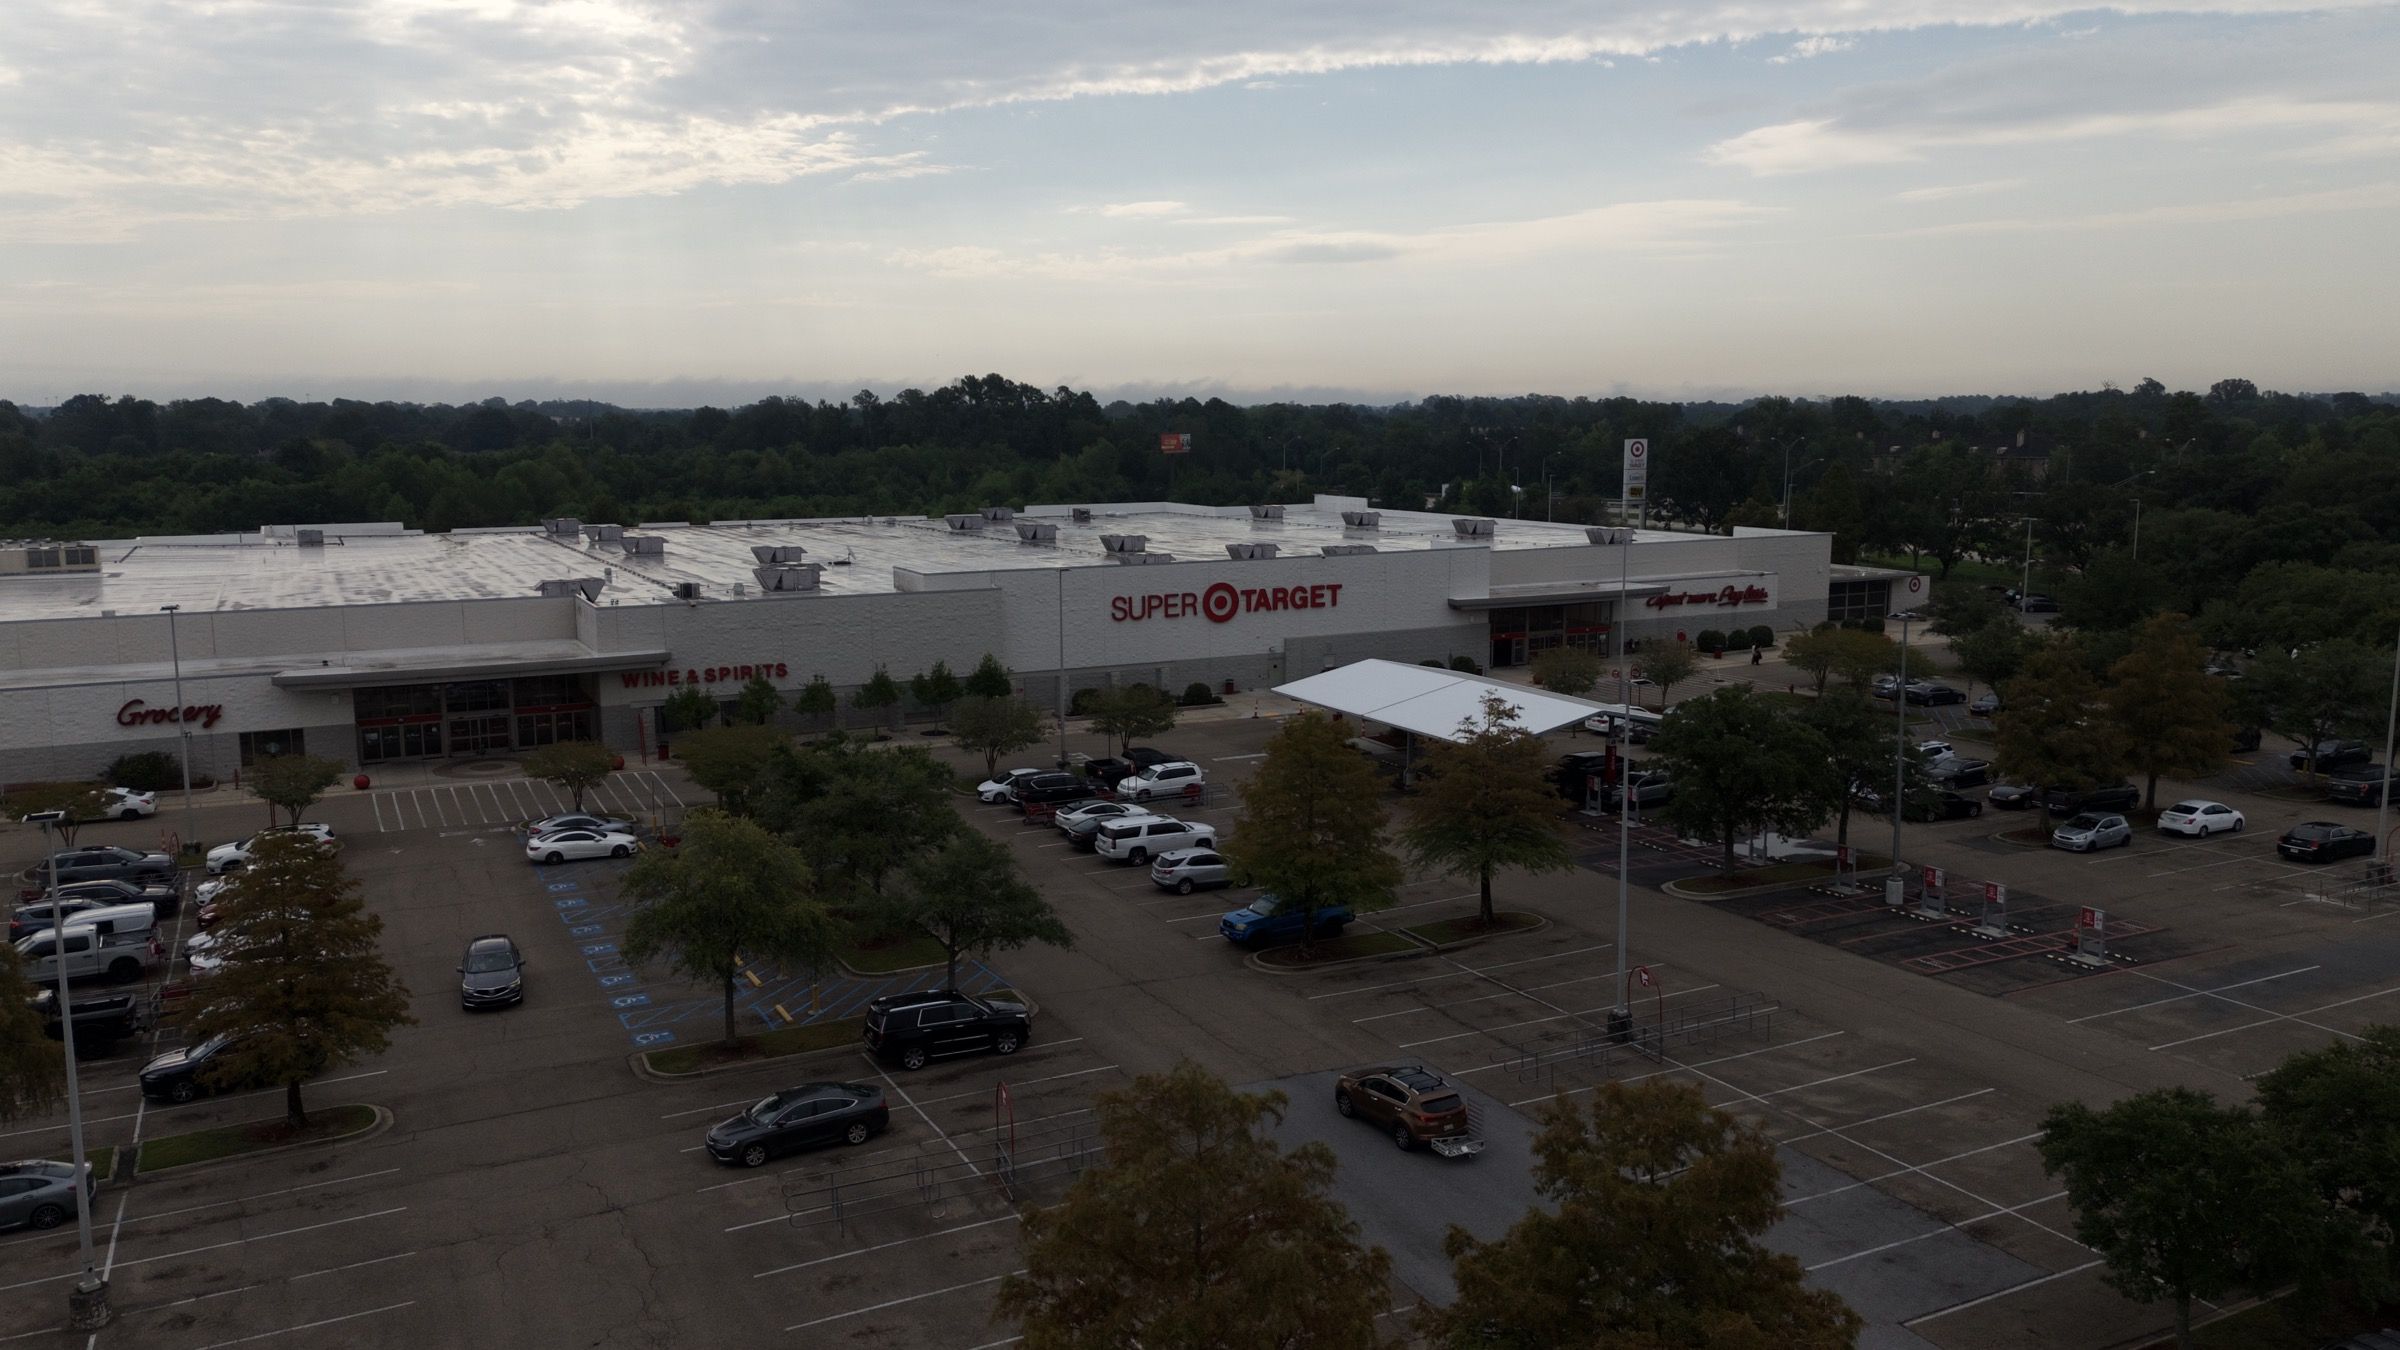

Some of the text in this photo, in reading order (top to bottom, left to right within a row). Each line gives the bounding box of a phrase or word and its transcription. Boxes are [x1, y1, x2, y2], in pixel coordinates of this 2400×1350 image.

[1111, 584, 1343, 622] SUPER TARGET
[621, 670, 679, 688] WINE
[686, 669, 699, 684] &
[117, 699, 222, 729] Grocery
